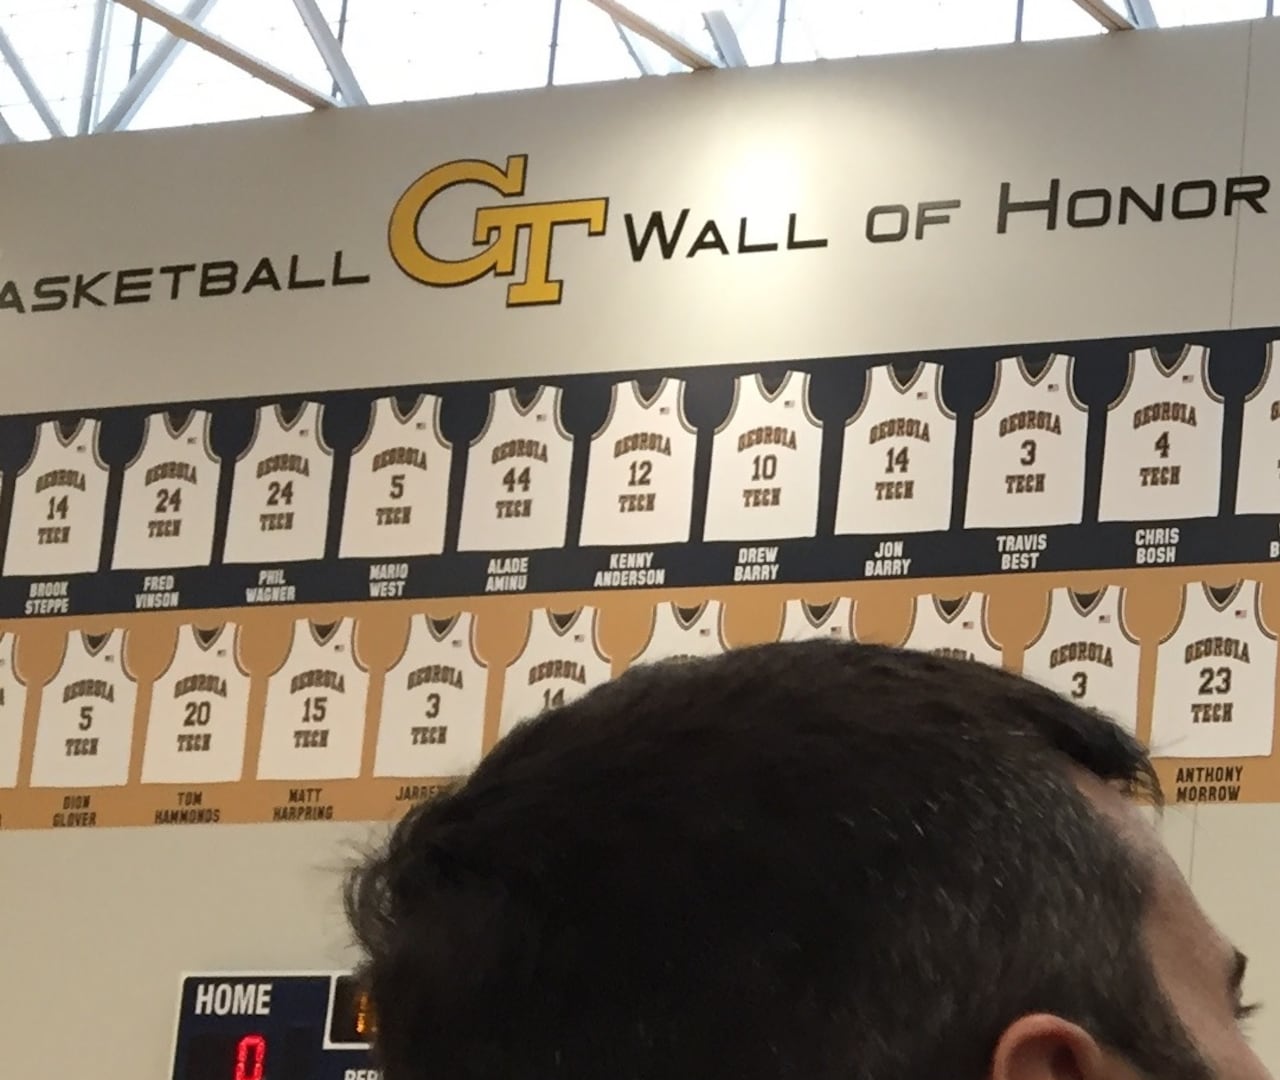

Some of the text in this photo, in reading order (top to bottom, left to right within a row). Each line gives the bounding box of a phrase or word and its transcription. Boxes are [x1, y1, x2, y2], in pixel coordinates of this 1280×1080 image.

[0, 251, 370, 314] ASKETBALL
[624, 209, 828, 262] WALL
[996, 175, 1270, 234] HONOR
[999, 410, 1061, 438] GEORGIA
[1133, 402, 1197, 429] GEORGIA
[738, 426, 797, 453] GEORGIA
[869, 418, 930, 444] GEORGIA
[491, 439, 548, 464] GEORGIA
[614, 432, 671, 459] GEORGIA
[1021, 440, 1036, 466] 3
[1155, 432, 1170, 458] 4
[256, 453, 310, 478] GEORGIA
[372, 447, 427, 472] GEORGIA
[751, 455, 777, 480] 10
[885, 447, 909, 473] 14
[36, 469, 86, 493] GEORGIA
[145, 461, 197, 487] GEORGIA
[502, 466, 531, 492] 44
[628, 460, 652, 486] 12
[1005, 473, 1045, 493] TECH
[1140, 465, 1180, 486] TECH
[743, 488, 781, 507] TECH
[875, 480, 914, 500] TECH
[496, 499, 532, 519] TECH
[619, 493, 656, 512] TECH
[260, 513, 294, 531] TECH
[376, 506, 411, 525] TECH
[38, 526, 71, 545] TECH
[148, 520, 182, 538] TECH
[1135, 528, 1180, 546] CHRIS
[874, 541, 903, 558] JON
[997, 534, 1047, 551] TRAVIS
[488, 557, 528, 573] ALADE
[610, 552, 654, 569] KENNY
[738, 547, 778, 564] DREW
[1001, 552, 1039, 570] BEST
[1136, 546, 1177, 564] BOSH
[594, 569, 665, 587] ANDERSON
[734, 564, 778, 581] BARRY
[864, 558, 911, 577] BARRY
[485, 574, 527, 592] AMINU
[1049, 641, 1113, 669] GEORGIA
[1184, 636, 1250, 663] GEORGIA
[290, 669, 345, 695] GEORGIA
[407, 664, 463, 691] GEORGIA
[528, 659, 586, 686] GEORGIA
[1198, 667, 1232, 695] 23
[62, 679, 115, 703] GEORGIA
[174, 674, 227, 699] GEORGIA
[1071, 671, 1087, 698] 3
[424, 693, 440, 718] 3
[1191, 702, 1233, 723] TECH
[177, 733, 211, 752] TECH
[293, 729, 329, 748] TECH
[410, 725, 447, 745] TECH
[64, 738, 99, 756] TECH
[1176, 765, 1243, 783] ANTHONY
[1176, 785, 1240, 802] MORROW
[195, 983, 272, 1015] HOME
